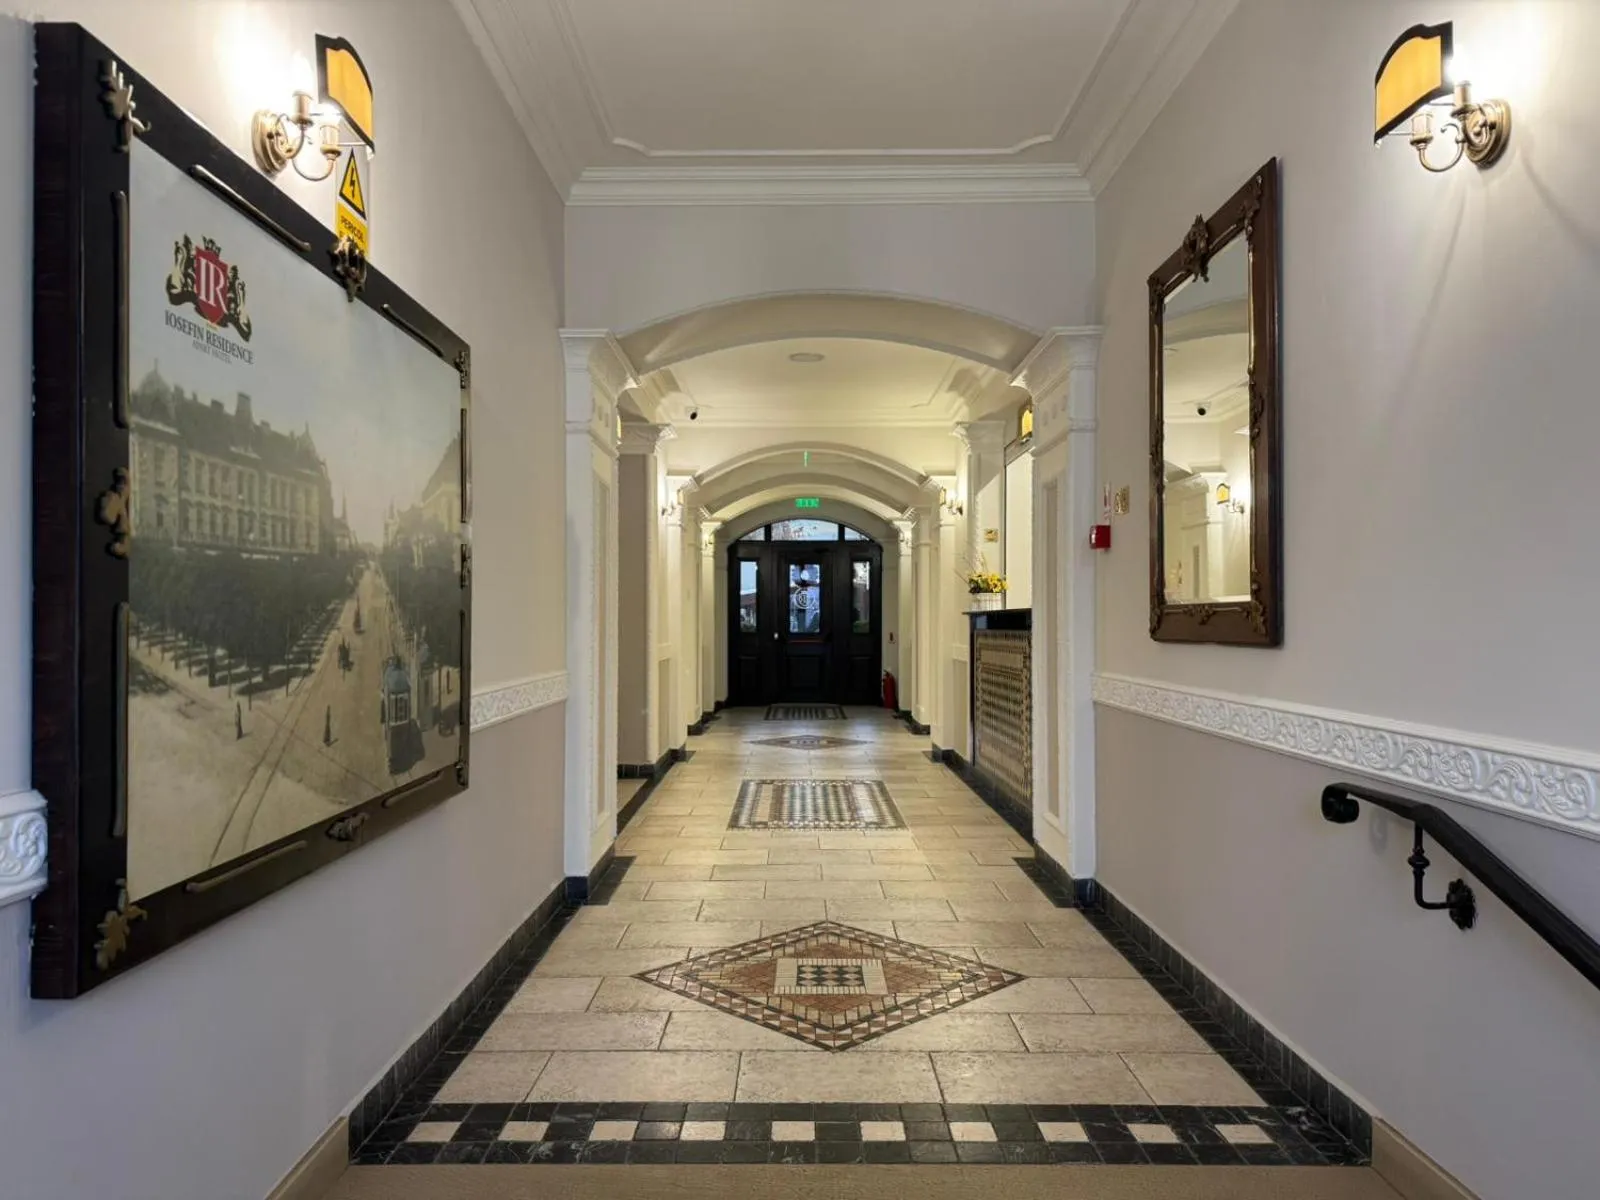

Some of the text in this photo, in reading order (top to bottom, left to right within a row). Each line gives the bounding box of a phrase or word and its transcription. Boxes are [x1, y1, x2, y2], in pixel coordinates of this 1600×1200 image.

[199, 257, 228, 314] IR
[165, 309, 254, 365] IOSEFIN RESIDENCE
